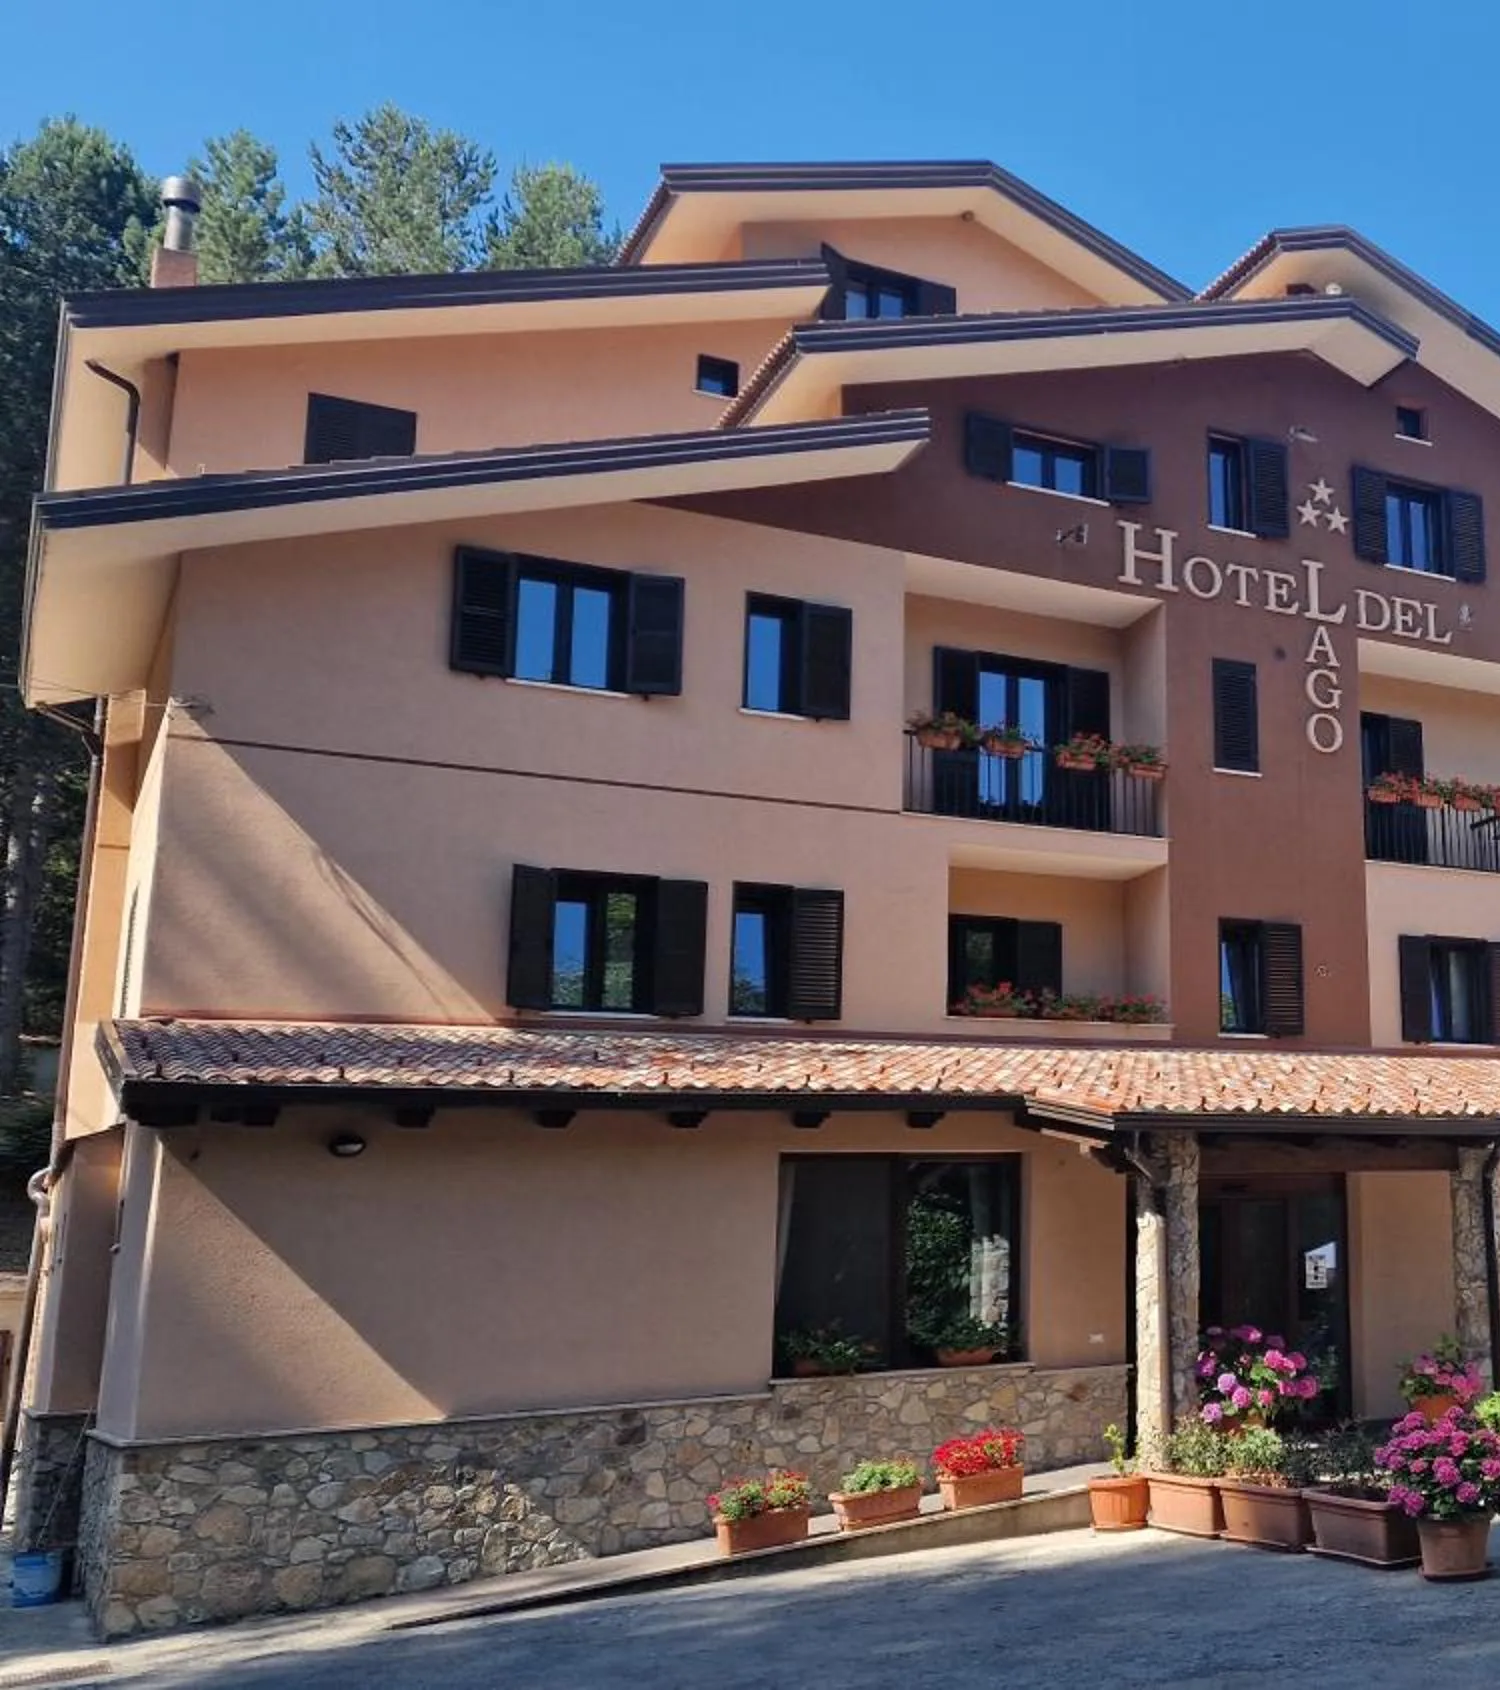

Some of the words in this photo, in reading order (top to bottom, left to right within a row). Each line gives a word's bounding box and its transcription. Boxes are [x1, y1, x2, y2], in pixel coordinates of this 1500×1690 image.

[1116, 519, 1347, 625] HOTEL
[1353, 589, 1453, 645] DEL
[1301, 559, 1347, 753] LAGO
